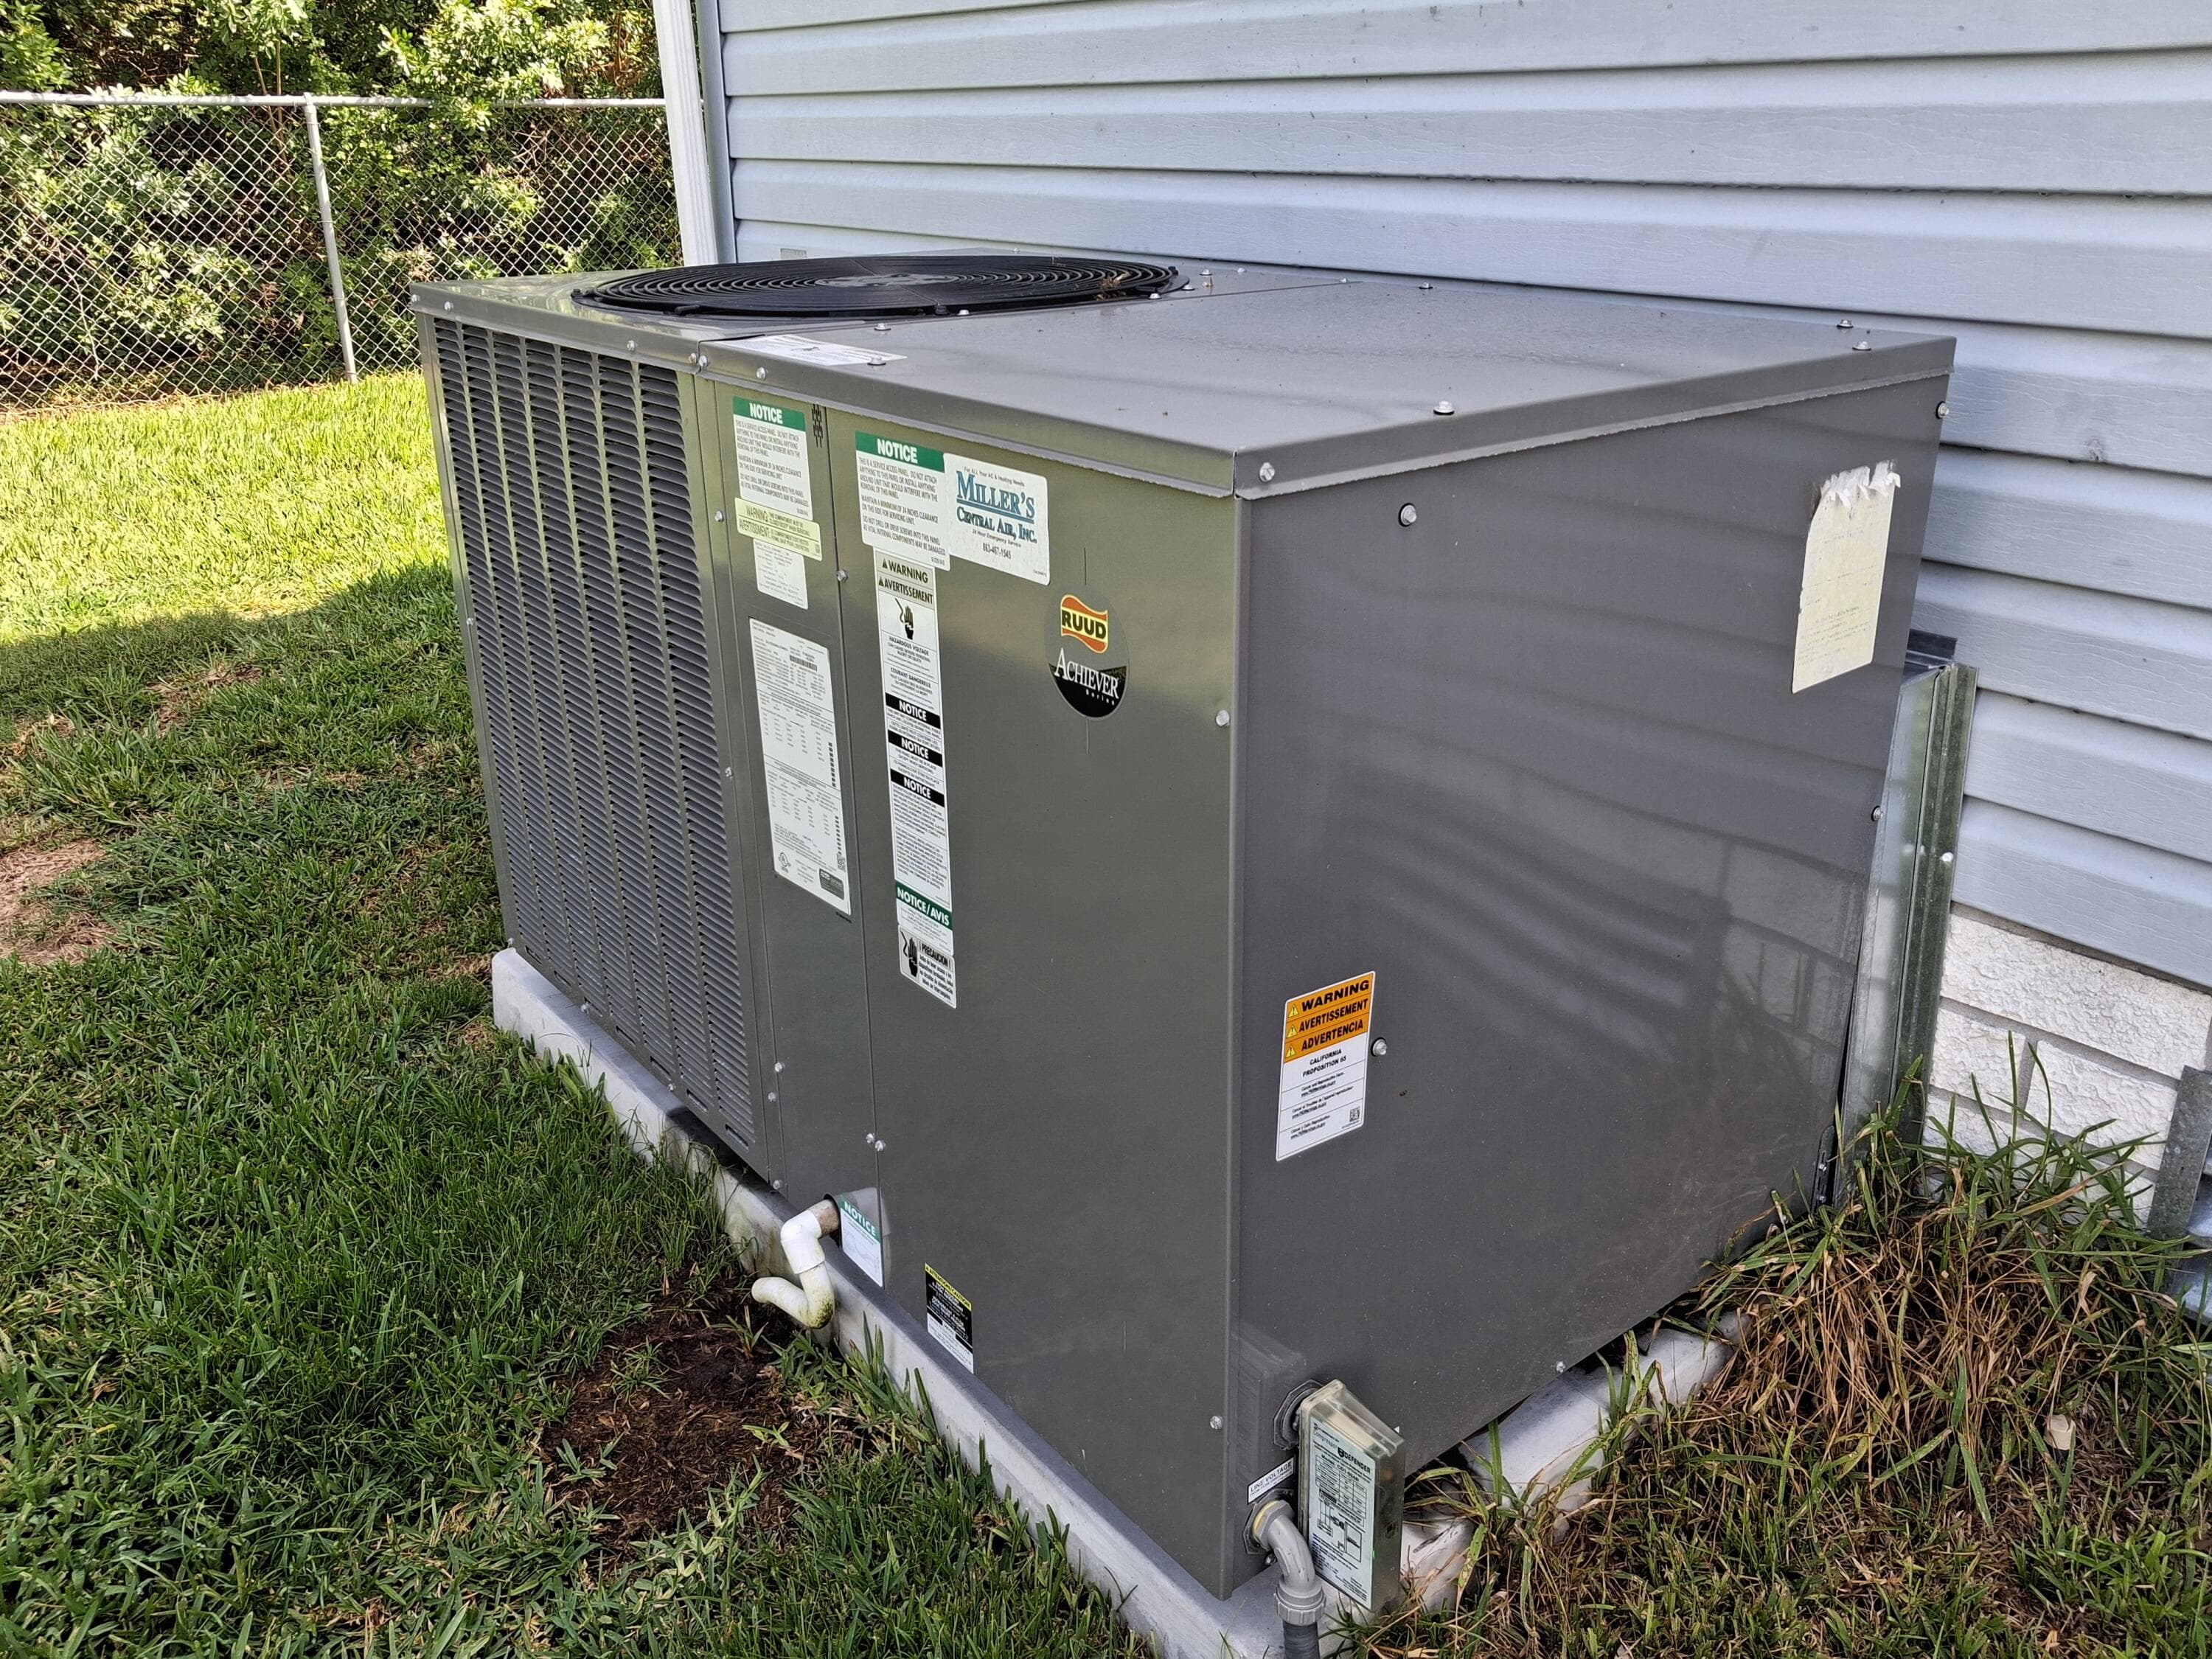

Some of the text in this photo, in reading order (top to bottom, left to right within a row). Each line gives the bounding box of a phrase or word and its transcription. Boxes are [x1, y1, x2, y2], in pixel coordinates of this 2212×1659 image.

[749, 402, 782, 424] NOTICE
[877, 438, 917, 464] NOTICE
[859, 466, 875, 476] ANYTHING
[905, 477, 917, 487] INSTALL
[917, 481, 935, 492] ANYTHING
[872, 461, 885, 470] SERVICE
[886, 464, 897, 473] ACCESS
[924, 473, 936, 483] ATTACH
[998, 475, 1012, 484] Heating
[860, 481, 874, 492] REMOVAL
[860, 474, 873, 484] AROUND
[882, 480, 890, 489] THAT
[891, 482, 902, 493] WOULD
[904, 486, 920, 497] INTERFERE
[921, 490, 930, 500] WITH
[861, 495, 877, 505] MAINTAIN
[880, 500, 897, 511] MINIMUM
[907, 507, 918, 517] INCHES
[919, 511, 938, 523] CLEARANCE
[889, 511, 905, 522] SERVICING
[868, 525, 876, 534] VITAL
[877, 528, 891, 538] INTERNAL
[892, 532, 914, 546] COMPONENTS
[875, 519, 884, 528] DRILL
[890, 524, 899, 532] DRIVE
[900, 526, 912, 537] SCREWS
[913, 530, 921, 539] INTO
[956, 505, 1037, 544] CENTRAL AIR, INC.
[987, 532, 1006, 544] Emergency
[1007, 539, 1020, 548] Service
[888, 560, 928, 584] WARNING
[884, 577, 933, 605] AVERTISSEMENT
[1062, 609, 1106, 639] RUUD
[888, 635, 928, 655] HAZARDOUS VOLTAGE
[915, 653, 931, 662] PERSONAL
[890, 667, 908, 678] COURANT
[1054, 647, 1119, 699] ACHIEVER
[1085, 689, 1115, 706] Series
[899, 699, 927, 722] NOTICE
[901, 737, 929, 759] NOTICE
[903, 776, 931, 799] NOTICE
[1301, 978, 1369, 1012] WARNING
[1298, 997, 1368, 1033] AVERTISSEMENT
[1301, 1018, 1363, 1051] ADVERTENCIA
[1302, 1058, 1338, 1077] PROPOSITION
[1310, 1048, 1341, 1065] CALIFORNIA
[844, 1199, 875, 1237] NOTICE
[1344, 1450, 1370, 1474] DEFENDER
[1251, 1479, 1262, 1492] LINE
[1265, 1460, 1292, 1482] VOLTAGE
